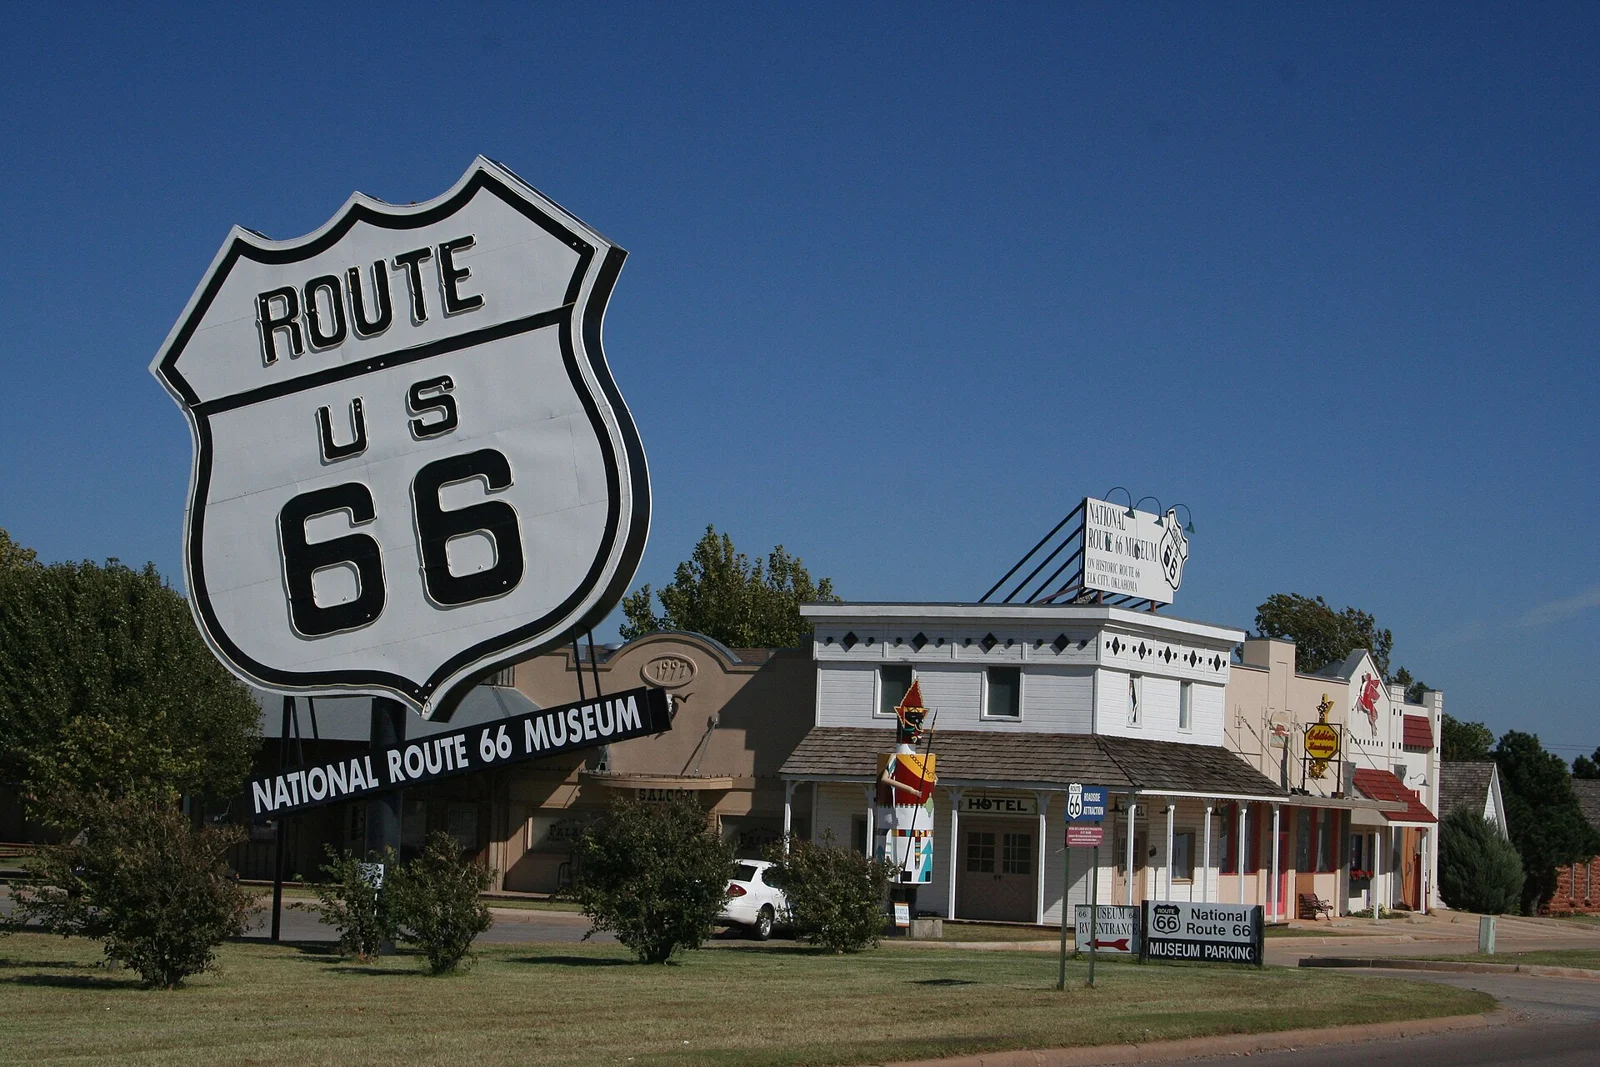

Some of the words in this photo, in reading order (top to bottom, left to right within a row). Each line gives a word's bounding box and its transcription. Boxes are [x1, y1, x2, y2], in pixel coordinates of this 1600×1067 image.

[256, 233, 485, 366] ROUTE
[316, 396, 369, 461] U
[405, 374, 461, 440] S
[1089, 503, 1126, 531] NATIONAL
[277, 447, 526, 638] 66
[1088, 528, 1113, 553] ROUTE
[1115, 535, 1123, 554] 66
[1125, 537, 1157, 562] MUSEUM
[1087, 557, 1095, 569] ON
[1095, 560, 1118, 575] HISTORIC
[1119, 564, 1134, 578] ROUTE
[1134, 568, 1141, 579] 66
[1164, 545, 1178, 580] 66
[1087, 572, 1097, 585] ELK
[1110, 577, 1138, 593] OKLAHOMA
[655, 659, 688, 681] 1997
[251, 754, 380, 815] NATIONAL
[386, 732, 468, 783] ROUTE
[478, 724, 513, 761] 66
[524, 695, 642, 752] MUSEUM
[968, 798, 1028, 812] HOTEL
[1069, 795, 1081, 815] 66
[1084, 793, 1101, 802] ROADSIDE
[1083, 806, 1104, 816] ATTRACTION
[1091, 907, 1125, 920] USEUM
[1156, 916, 1177, 930] 66
[1191, 908, 1247, 922] National
[1079, 922, 1090, 934] RV
[1187, 922, 1226, 936] Route
[1233, 925, 1251, 937] 66
[1149, 941, 1200, 957] MUSEUM
[1205, 944, 1255, 960] PARKING
